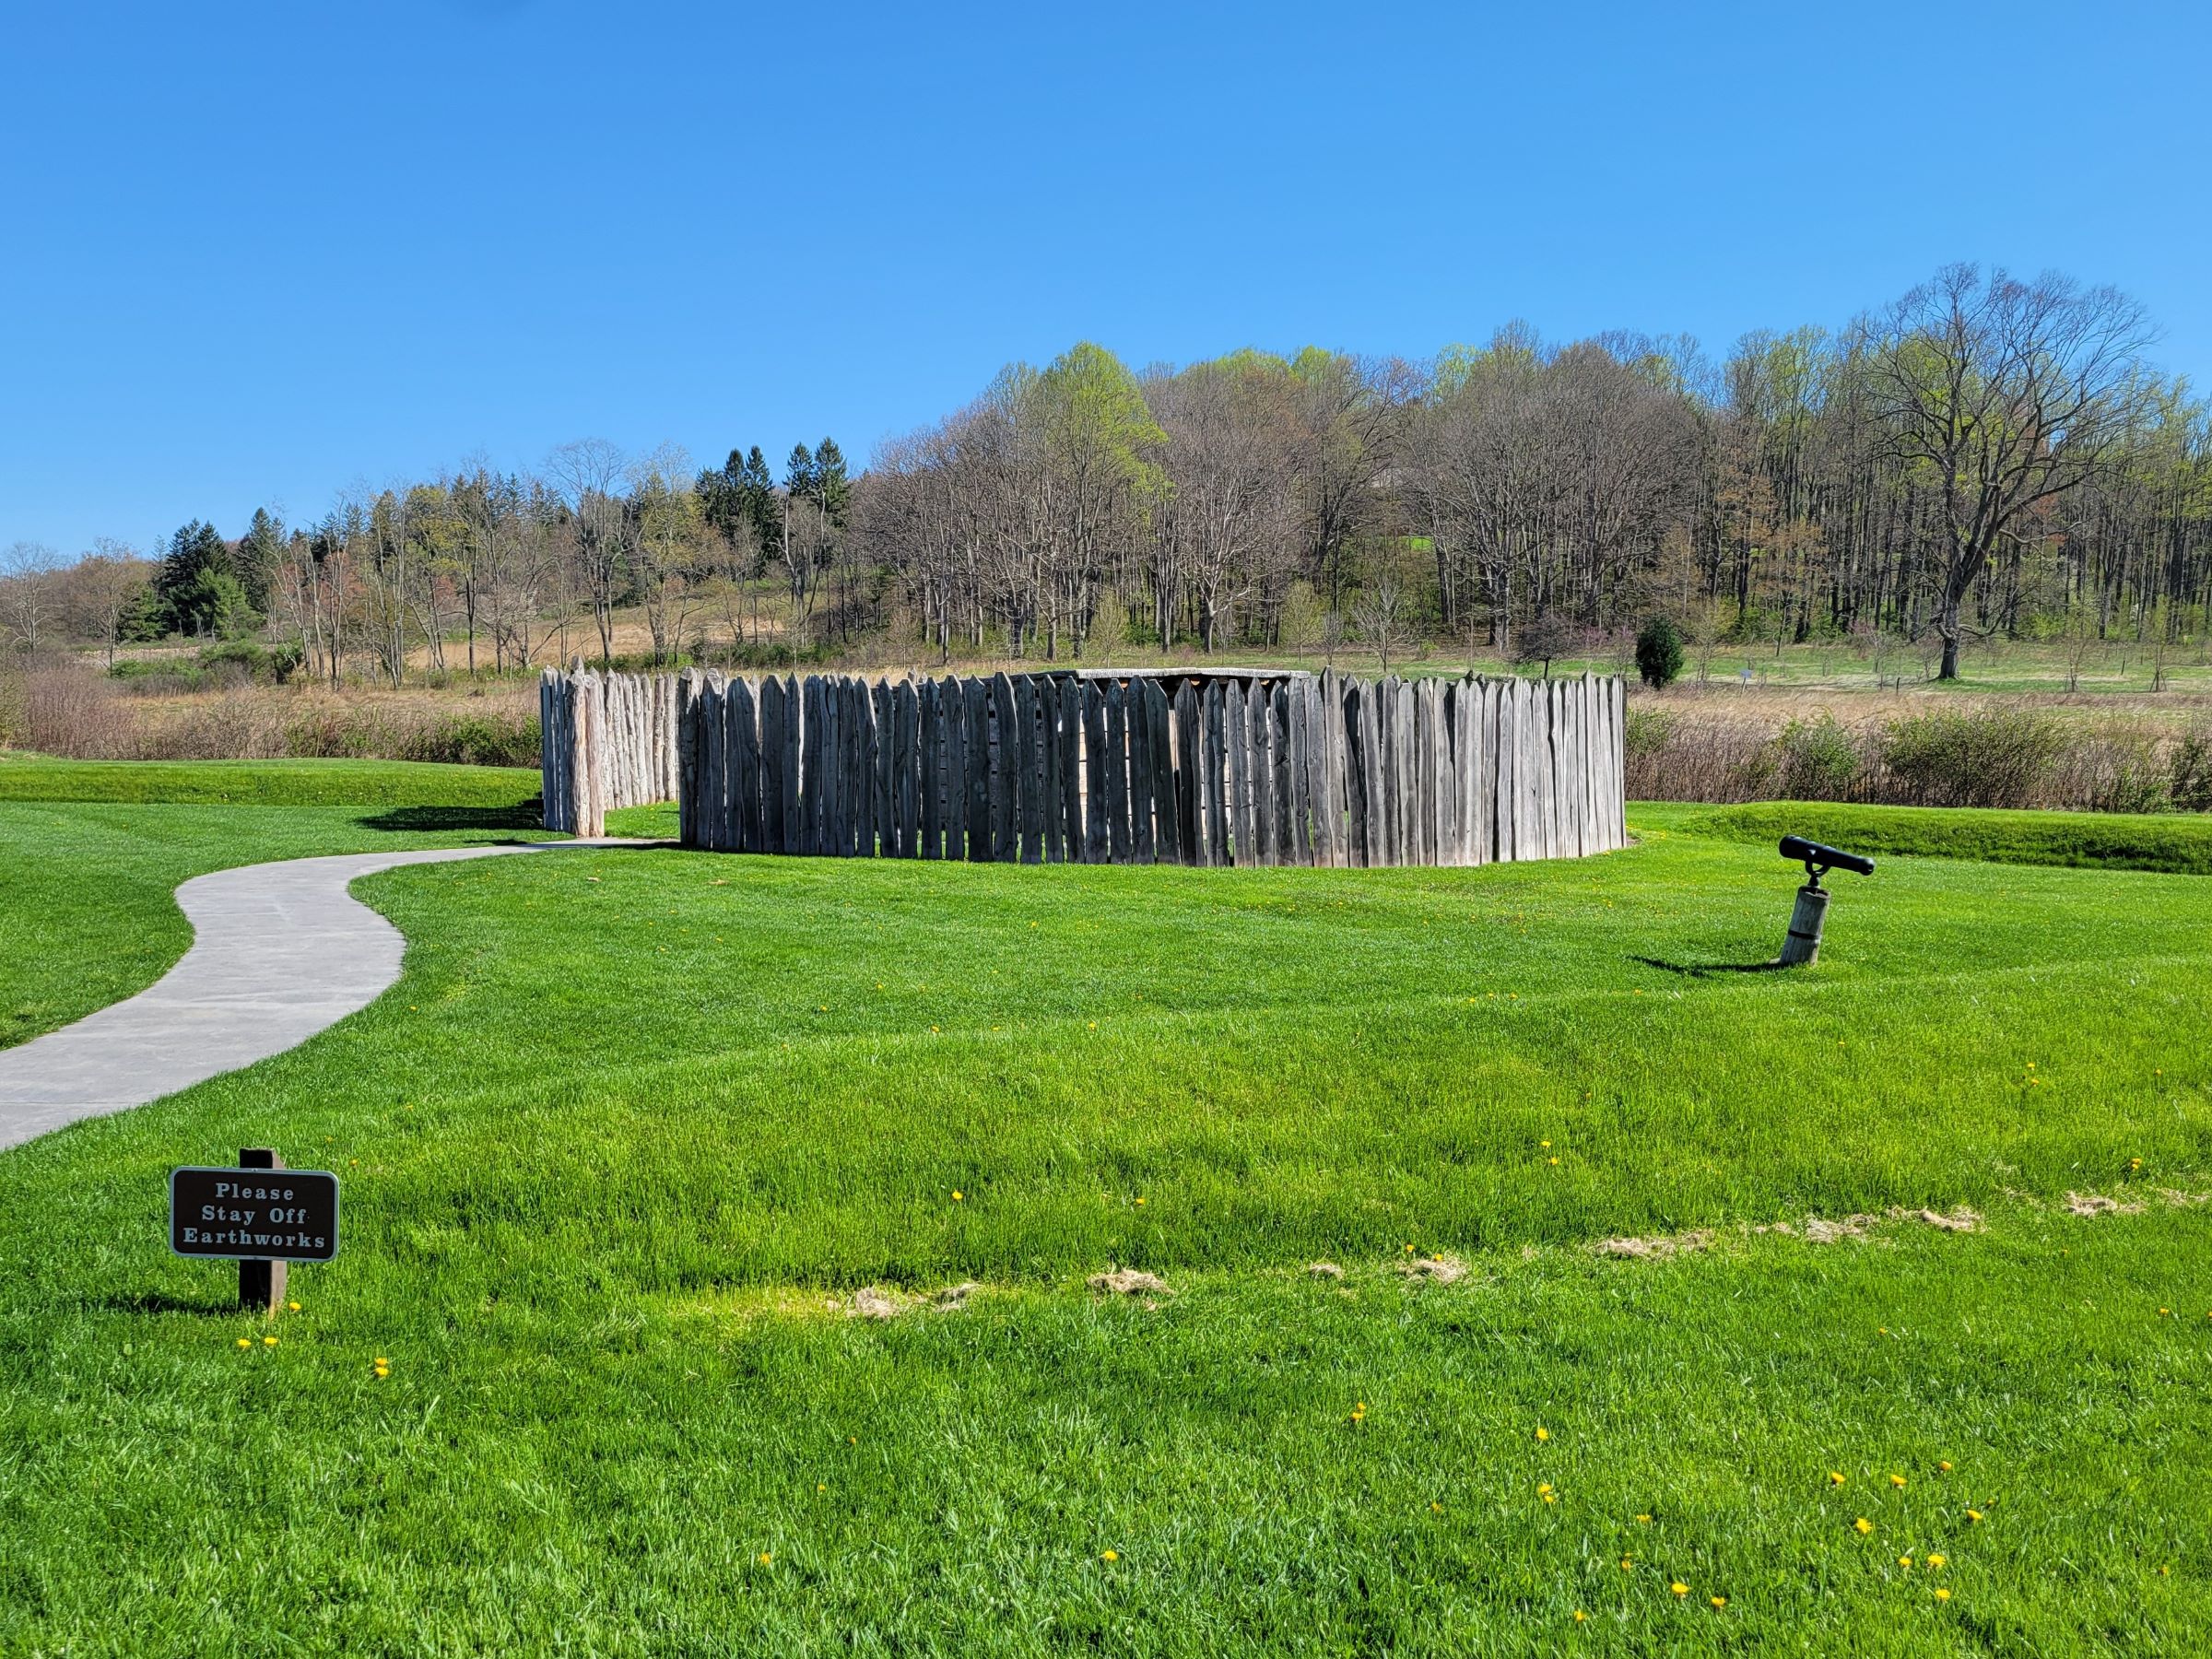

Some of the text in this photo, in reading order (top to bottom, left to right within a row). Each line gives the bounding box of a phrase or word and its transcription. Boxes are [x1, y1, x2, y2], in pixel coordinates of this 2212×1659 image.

[215, 1182, 294, 1201] Please
[201, 1205, 307, 1226] Stay Off
[182, 1227, 325, 1249] Earthworks
